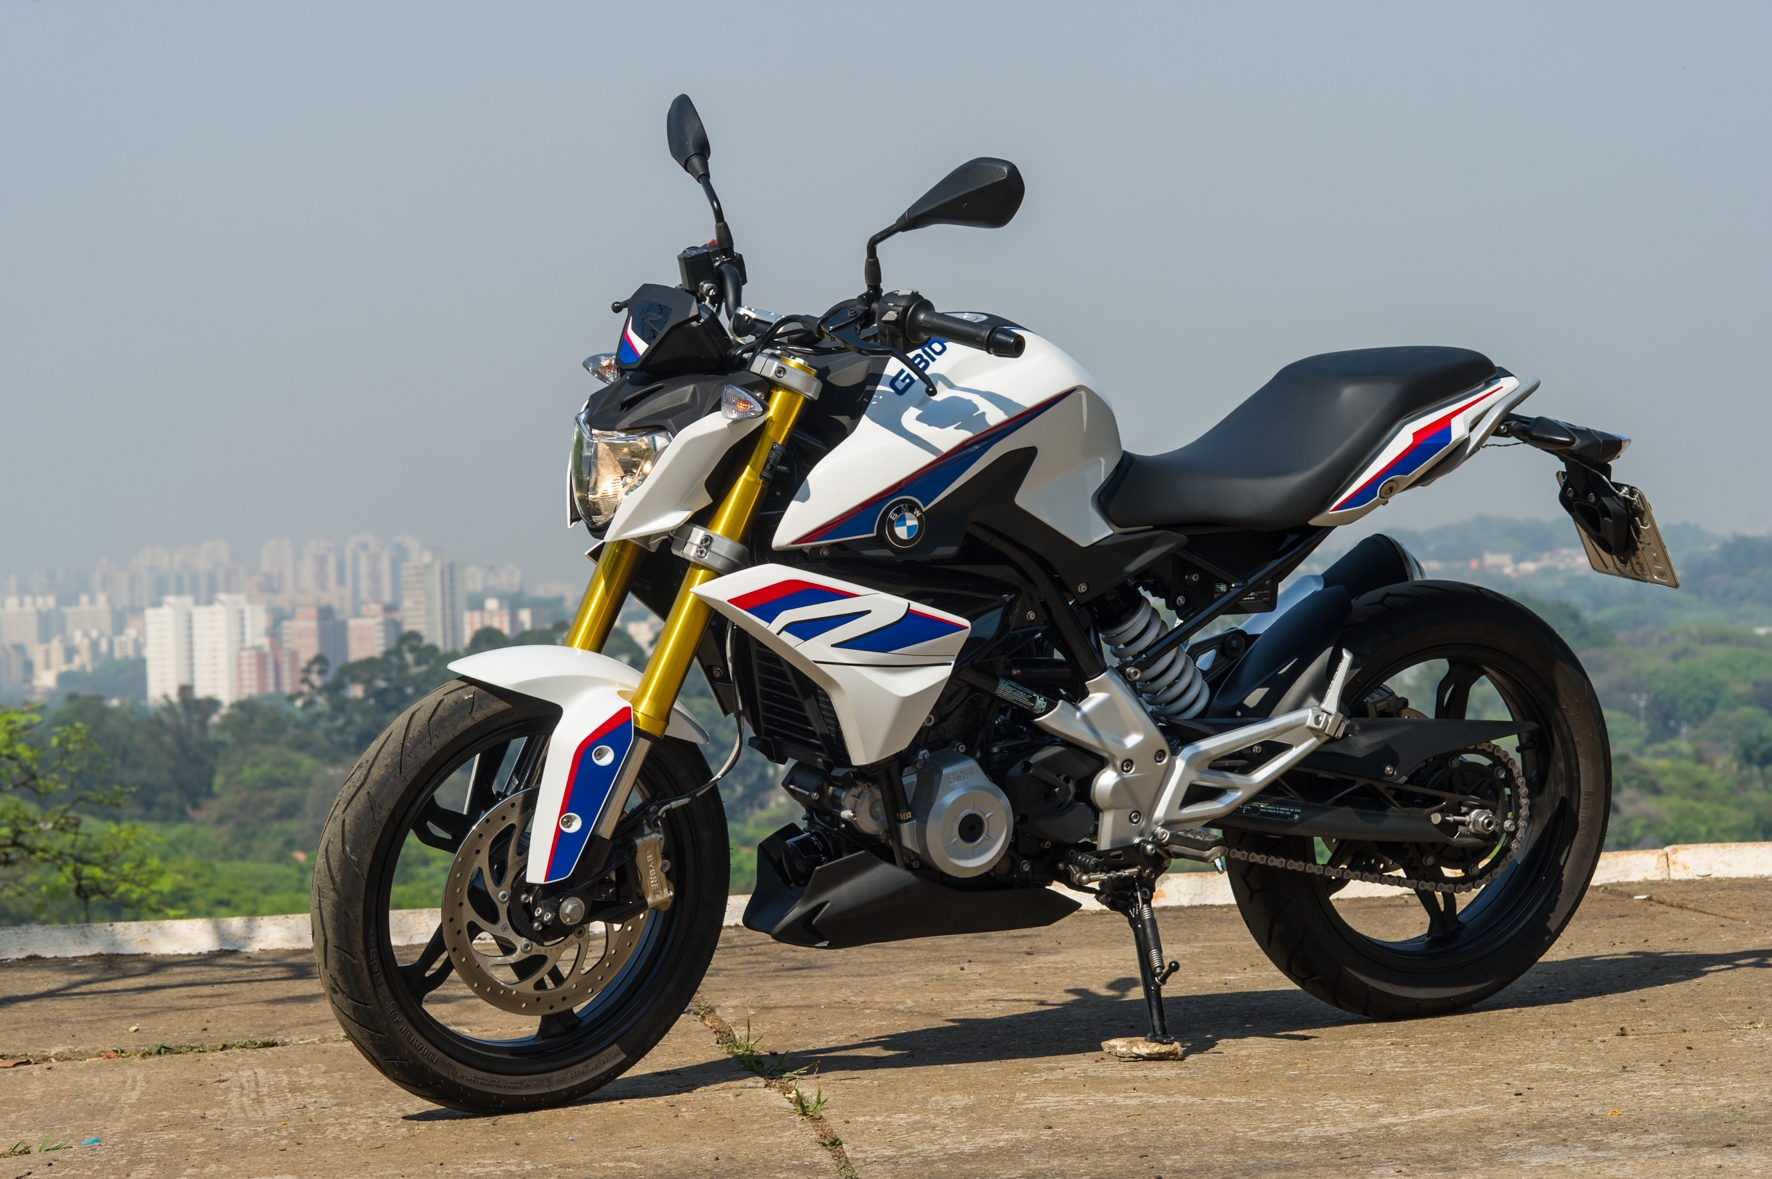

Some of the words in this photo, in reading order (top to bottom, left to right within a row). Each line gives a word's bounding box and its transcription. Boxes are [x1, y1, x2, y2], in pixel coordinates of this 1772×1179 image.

[889, 368, 916, 396] G
[910, 340, 947, 373] 310
[889, 504, 922, 521] BMW
[646, 854, 659, 891] BYBRE
[389, 1008, 439, 1065] DIABLO
